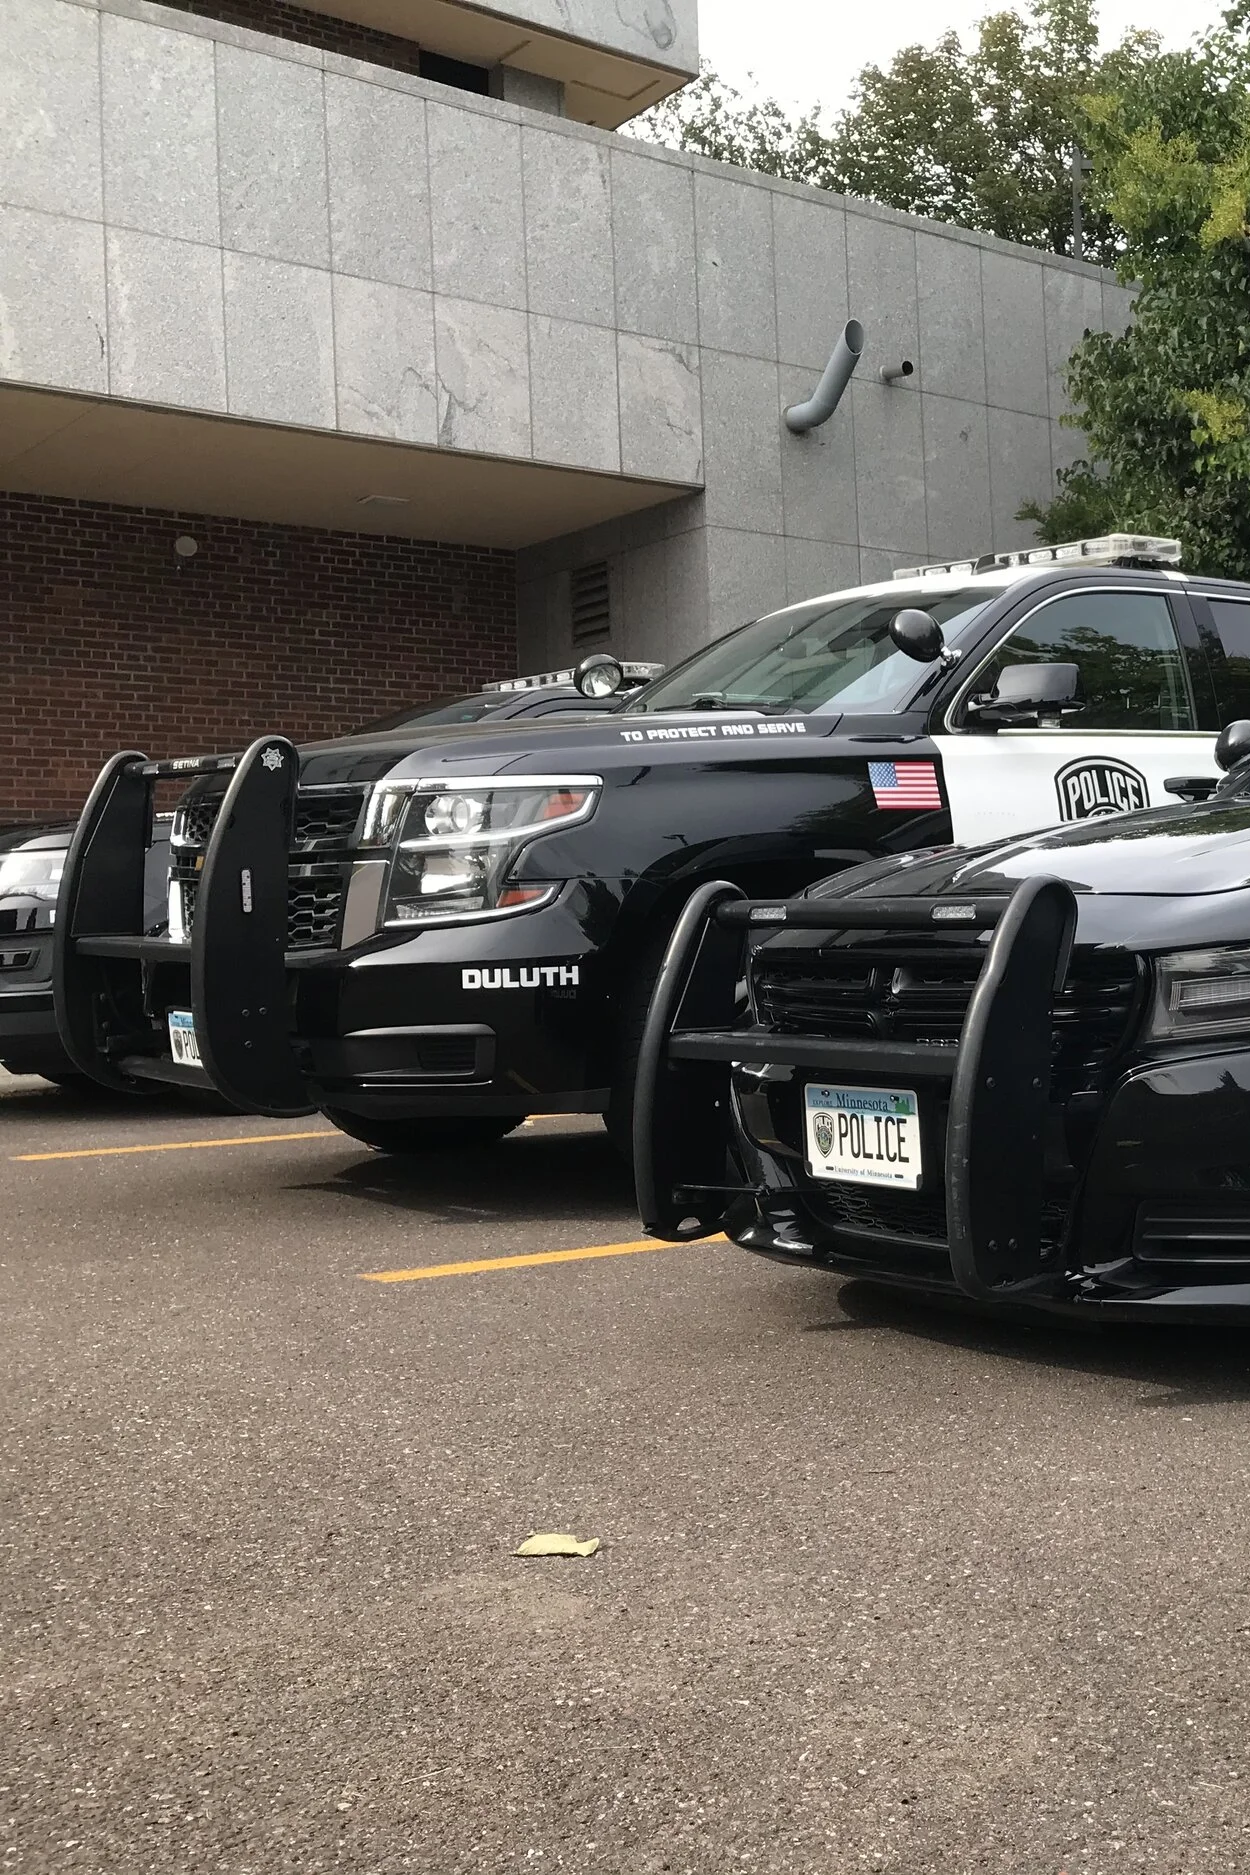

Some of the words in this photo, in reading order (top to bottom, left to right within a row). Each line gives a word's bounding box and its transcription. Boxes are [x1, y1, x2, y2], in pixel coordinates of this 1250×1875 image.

[620, 731, 644, 742] TO
[647, 726, 717, 740] PROTECT
[721, 724, 754, 736] AND
[758, 722, 807, 734] SERVE
[172, 759, 200, 770] SETINA
[1066, 769, 1140, 820] POLICE
[461, 965, 580, 989] DULUTH
[835, 1092, 889, 1112] Minnesota
[838, 1112, 910, 1163] POLICE
[834, 1165, 859, 1177] University
[866, 1169, 893, 1179] Minnesota
